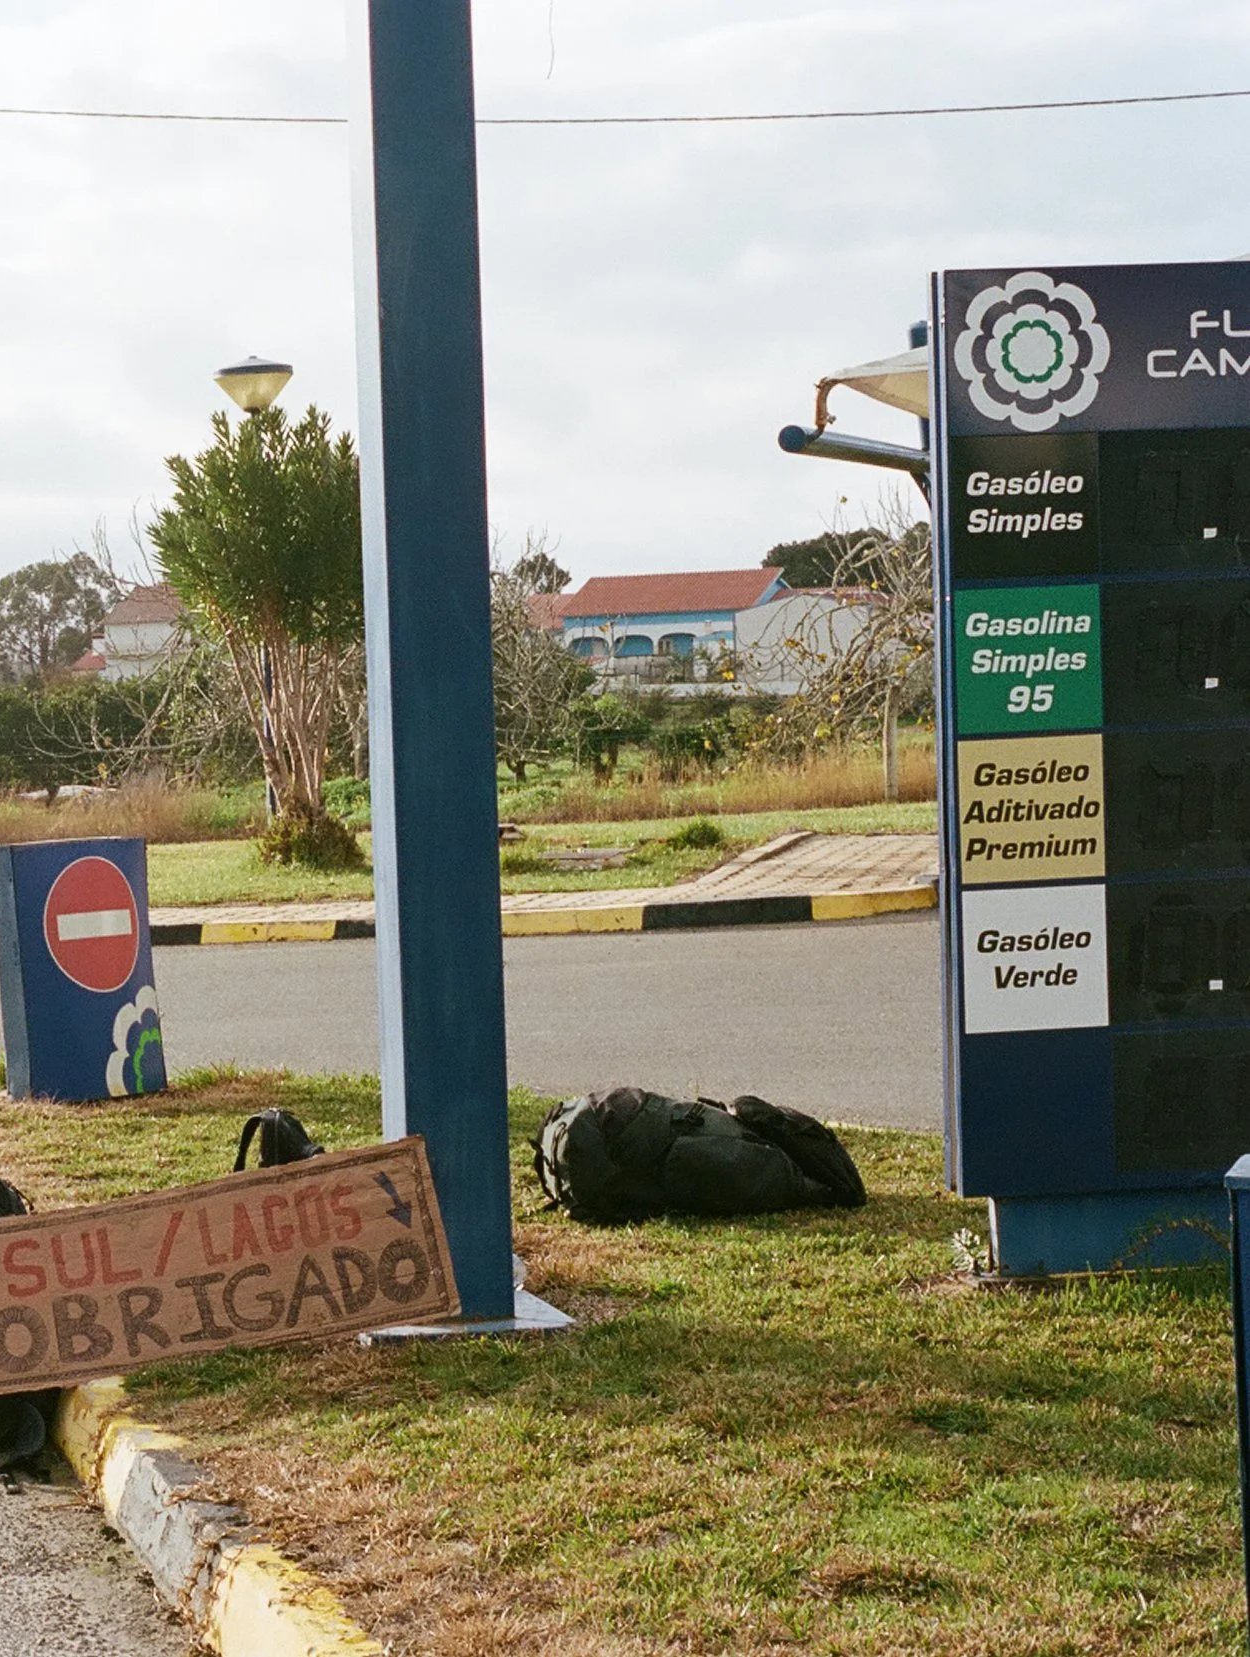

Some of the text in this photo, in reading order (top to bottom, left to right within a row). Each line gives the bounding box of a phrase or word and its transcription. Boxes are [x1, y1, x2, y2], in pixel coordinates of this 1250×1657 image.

[966, 470, 1084, 496] Gasóleo
[967, 507, 1083, 538] Simples
[965, 610, 1092, 637] Gasolina
[971, 647, 1088, 678] Simples
[1007, 685, 1054, 713] 95
[973, 759, 1090, 787] Gasóleo
[963, 795, 1100, 825] Aditivado
[965, 833, 1097, 862] Premium
[976, 927, 1092, 954] Gasóleo
[994, 963, 1078, 989] Verde
